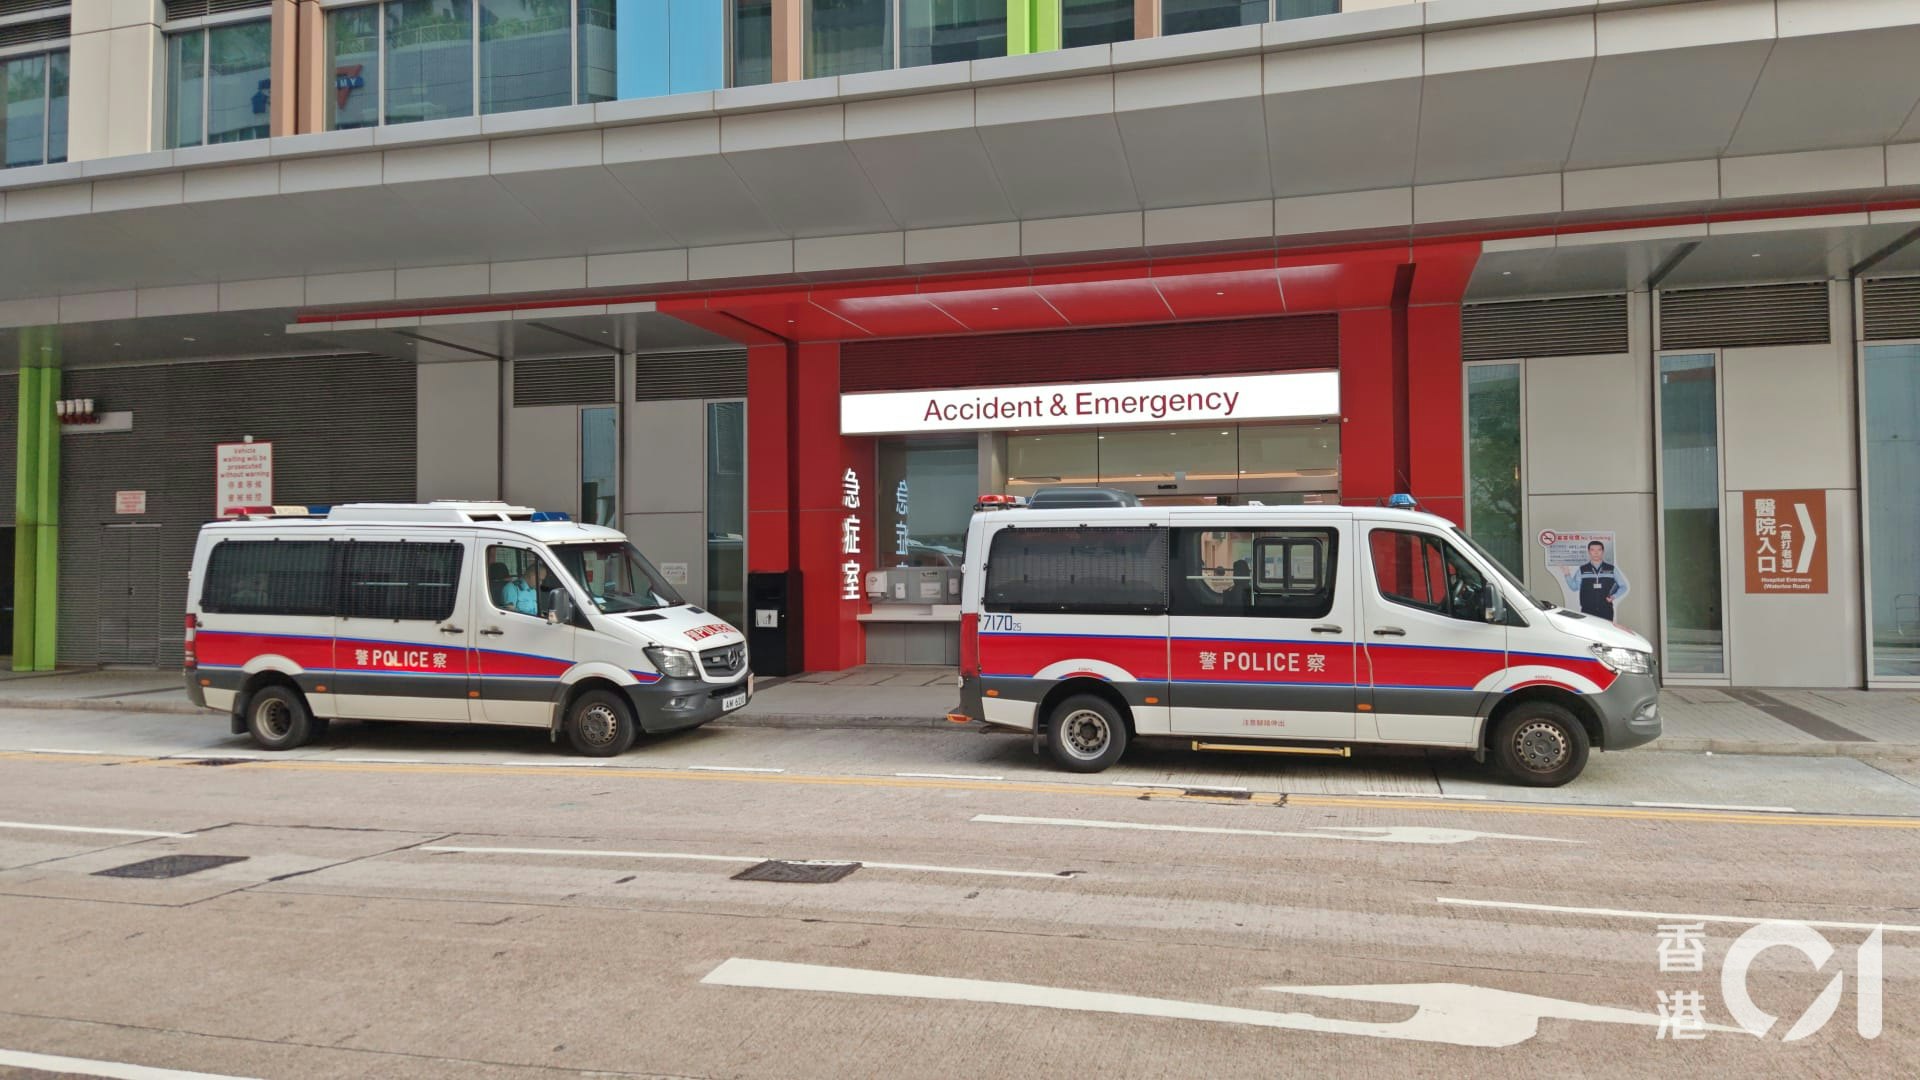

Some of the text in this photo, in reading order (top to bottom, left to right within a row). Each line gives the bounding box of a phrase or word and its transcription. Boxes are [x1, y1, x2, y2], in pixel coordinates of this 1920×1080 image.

[924, 391, 1239, 421] Accident & Emergency
[842, 467, 861, 600] 急症室
[1755, 498, 1777, 573] 醫院入口
[984, 614, 1013, 631] 7170
[355, 649, 447, 669] 警 POLICE 察
[1199, 651, 1326, 673] 警 POLICE 察
